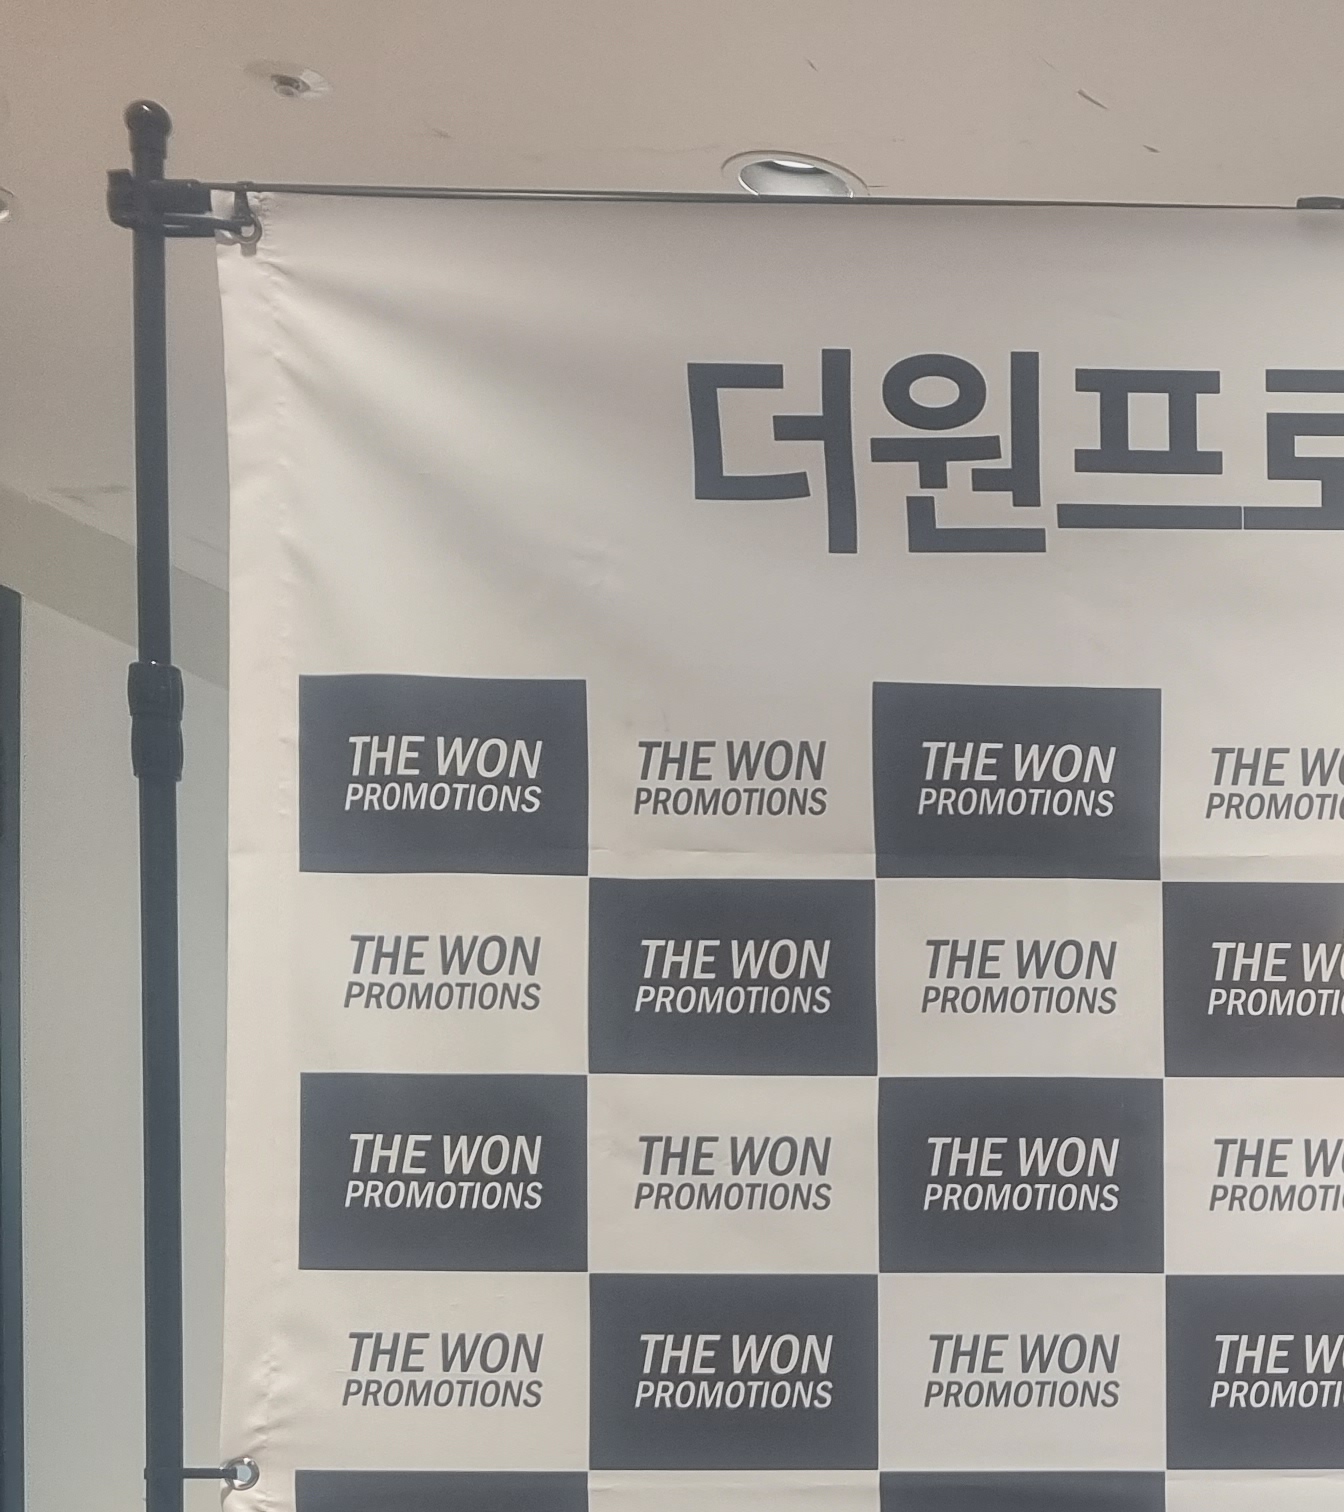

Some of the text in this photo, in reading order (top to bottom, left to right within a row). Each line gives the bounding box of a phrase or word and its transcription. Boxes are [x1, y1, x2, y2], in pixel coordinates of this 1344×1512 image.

[348, 734, 544, 780] THE WON
[921, 741, 1117, 784] THE WON
[344, 781, 543, 814] PROMOTIONS
[917, 787, 1115, 818] PROMOTIONS
[349, 934, 542, 977] THE WON
[343, 980, 542, 1011] PROMOTIONS
[638, 1135, 832, 1177] THE WON
[1213, 1137, 1294, 1178] THE
[633, 1182, 833, 1211] PROMOTIONS
[639, 1333, 834, 1376] THE WON
[634, 1380, 834, 1410] PROMOTIONS
